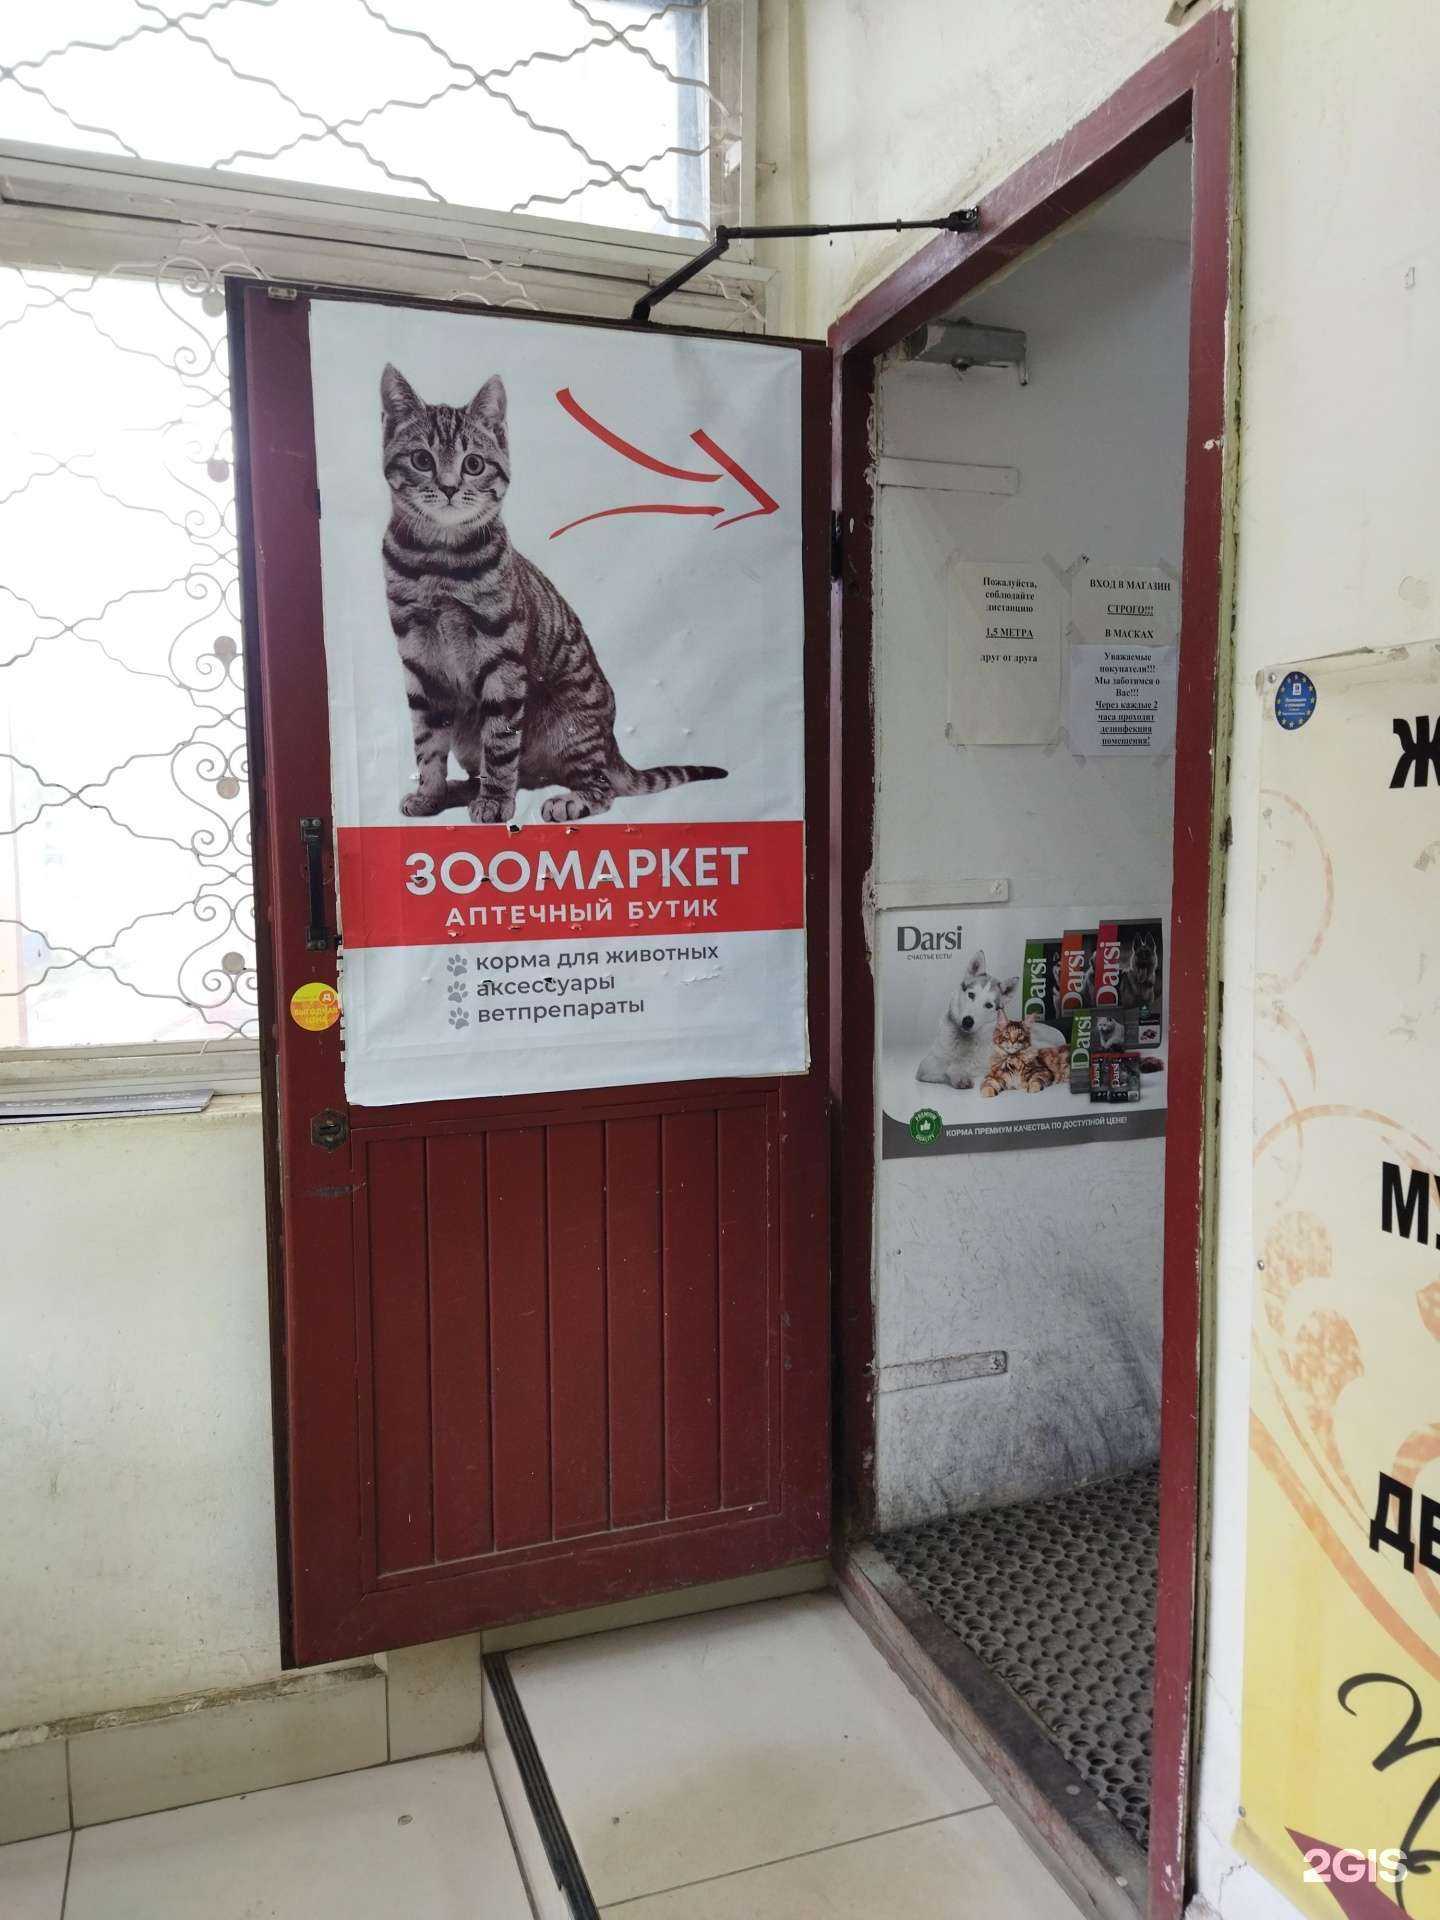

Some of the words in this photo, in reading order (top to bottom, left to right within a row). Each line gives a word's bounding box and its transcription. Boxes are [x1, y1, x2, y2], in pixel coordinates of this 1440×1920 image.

[983, 577, 1037, 590] Пожалуйста,
[1090, 579, 1116, 589] ВХОД
[1118, 581, 1124, 589] В
[1127, 581, 1171, 592] МАГАЗИН
[985, 591, 1035, 601] соблюдайте
[986, 604, 1034, 613] дистанцию
[1107, 604, 1154, 616] СТРОГО!!!
[986, 627, 998, 638] 1,5
[1000, 628, 1034, 639] МЕТРА
[1105, 629, 1111, 637] В
[1114, 629, 1154, 639] МАСКАХ
[980, 654, 1001, 664] друг
[1014, 655, 1038, 664] друга
[1104, 652, 1152, 662] Уважаемые
[1099, 664, 1156, 674] покупатели!!!
[1095, 676, 1110, 685] Мы
[1113, 677, 1153, 685] заботимся
[1116, 688, 1139, 697] Вас!!!
[1095, 701, 1119, 711] Через
[1121, 701, 1152, 711] каждые
[1097, 714, 1116, 722] часа
[1118, 714, 1155, 723] проходит
[405, 846, 748, 896] ЗООМАРКЕТ
[445, 898, 613, 928] АПТЕЧНЫЙ
[629, 898, 718, 920] БУТИК
[897, 925, 962, 951] Darsi
[475, 951, 550, 974] корма
[557, 949, 599, 970] для
[606, 944, 719, 965] животных
[1062, 950, 1085, 1010] Darsi
[1096, 941, 1121, 1008] Darsi
[476, 974, 616, 999] аксессуары
[1024, 957, 1047, 1022] Darsi
[478, 998, 645, 1024] ветпрепараты
[1071, 1015, 1091, 1069] Darsi
[946, 1128, 973, 1137] КОРМА
[975, 1125, 1012, 1135] ПРЕМИУМ
[1013, 1123, 1050, 1133] КАЧЕСТВА
[1052, 1122, 1062, 1130] ПО
[1062, 1117, 1105, 1129] ДОСТУПНОЙ
[1106, 1116, 1128, 1126] ЦЕНЕ!
